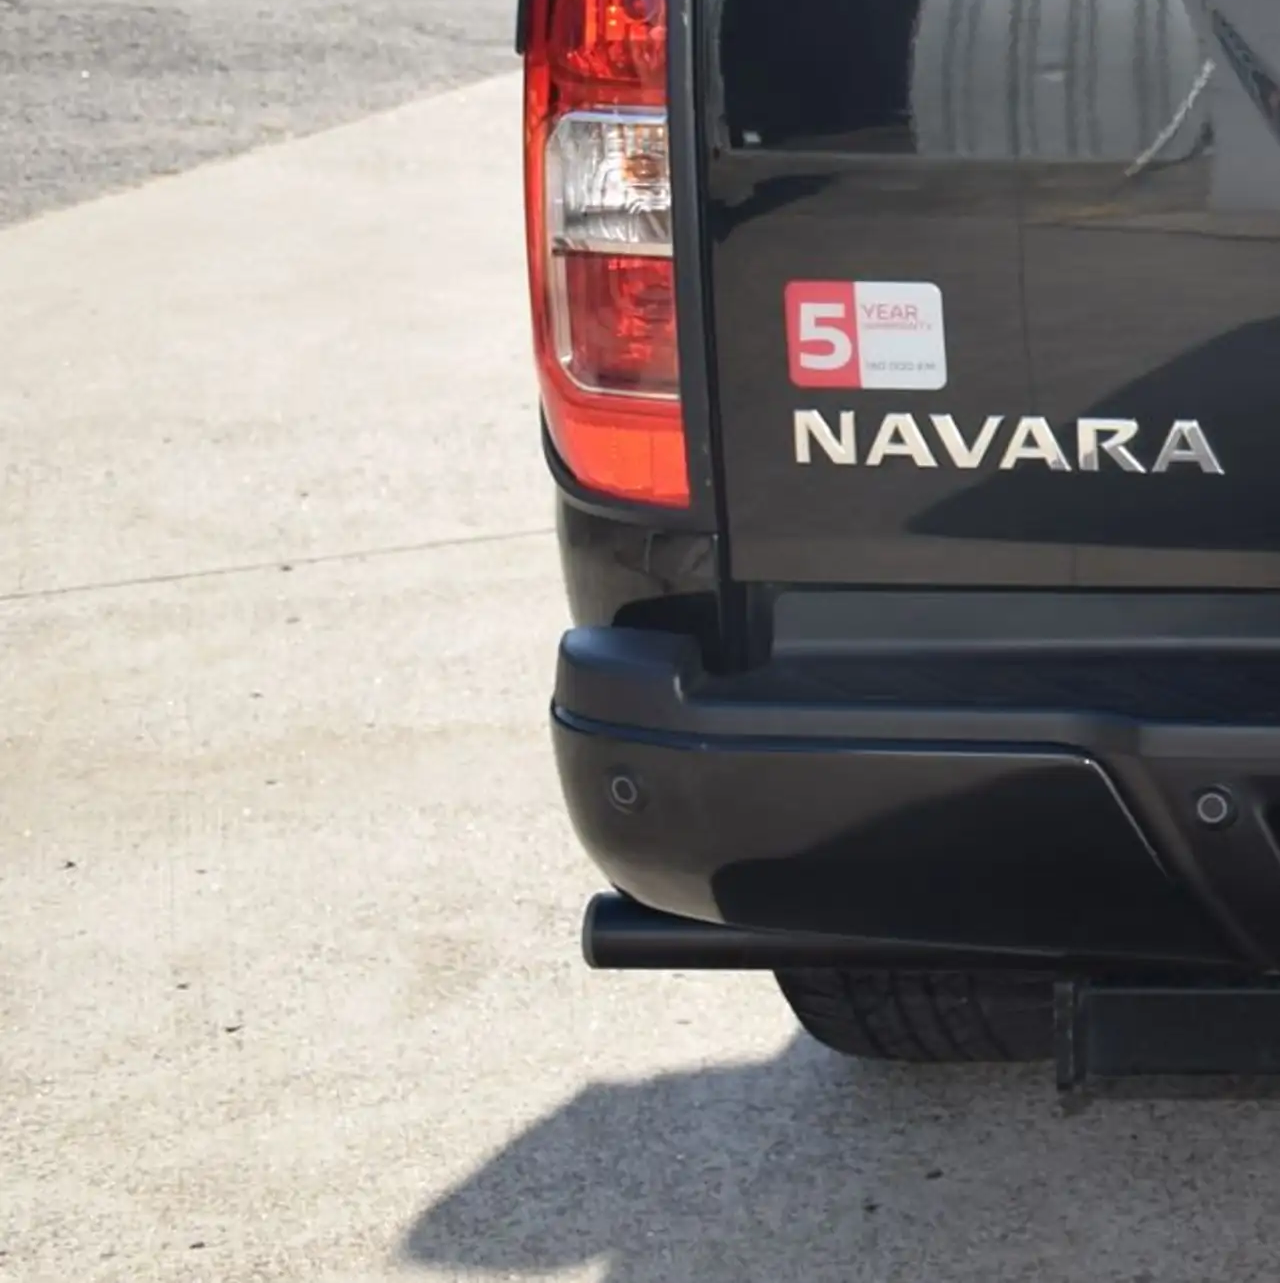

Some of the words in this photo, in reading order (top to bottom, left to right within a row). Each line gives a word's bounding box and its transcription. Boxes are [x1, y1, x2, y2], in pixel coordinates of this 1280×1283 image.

[799, 302, 853, 370] 5
[861, 303, 919, 321] YEAR
[794, 409, 1225, 475] NAVARA
